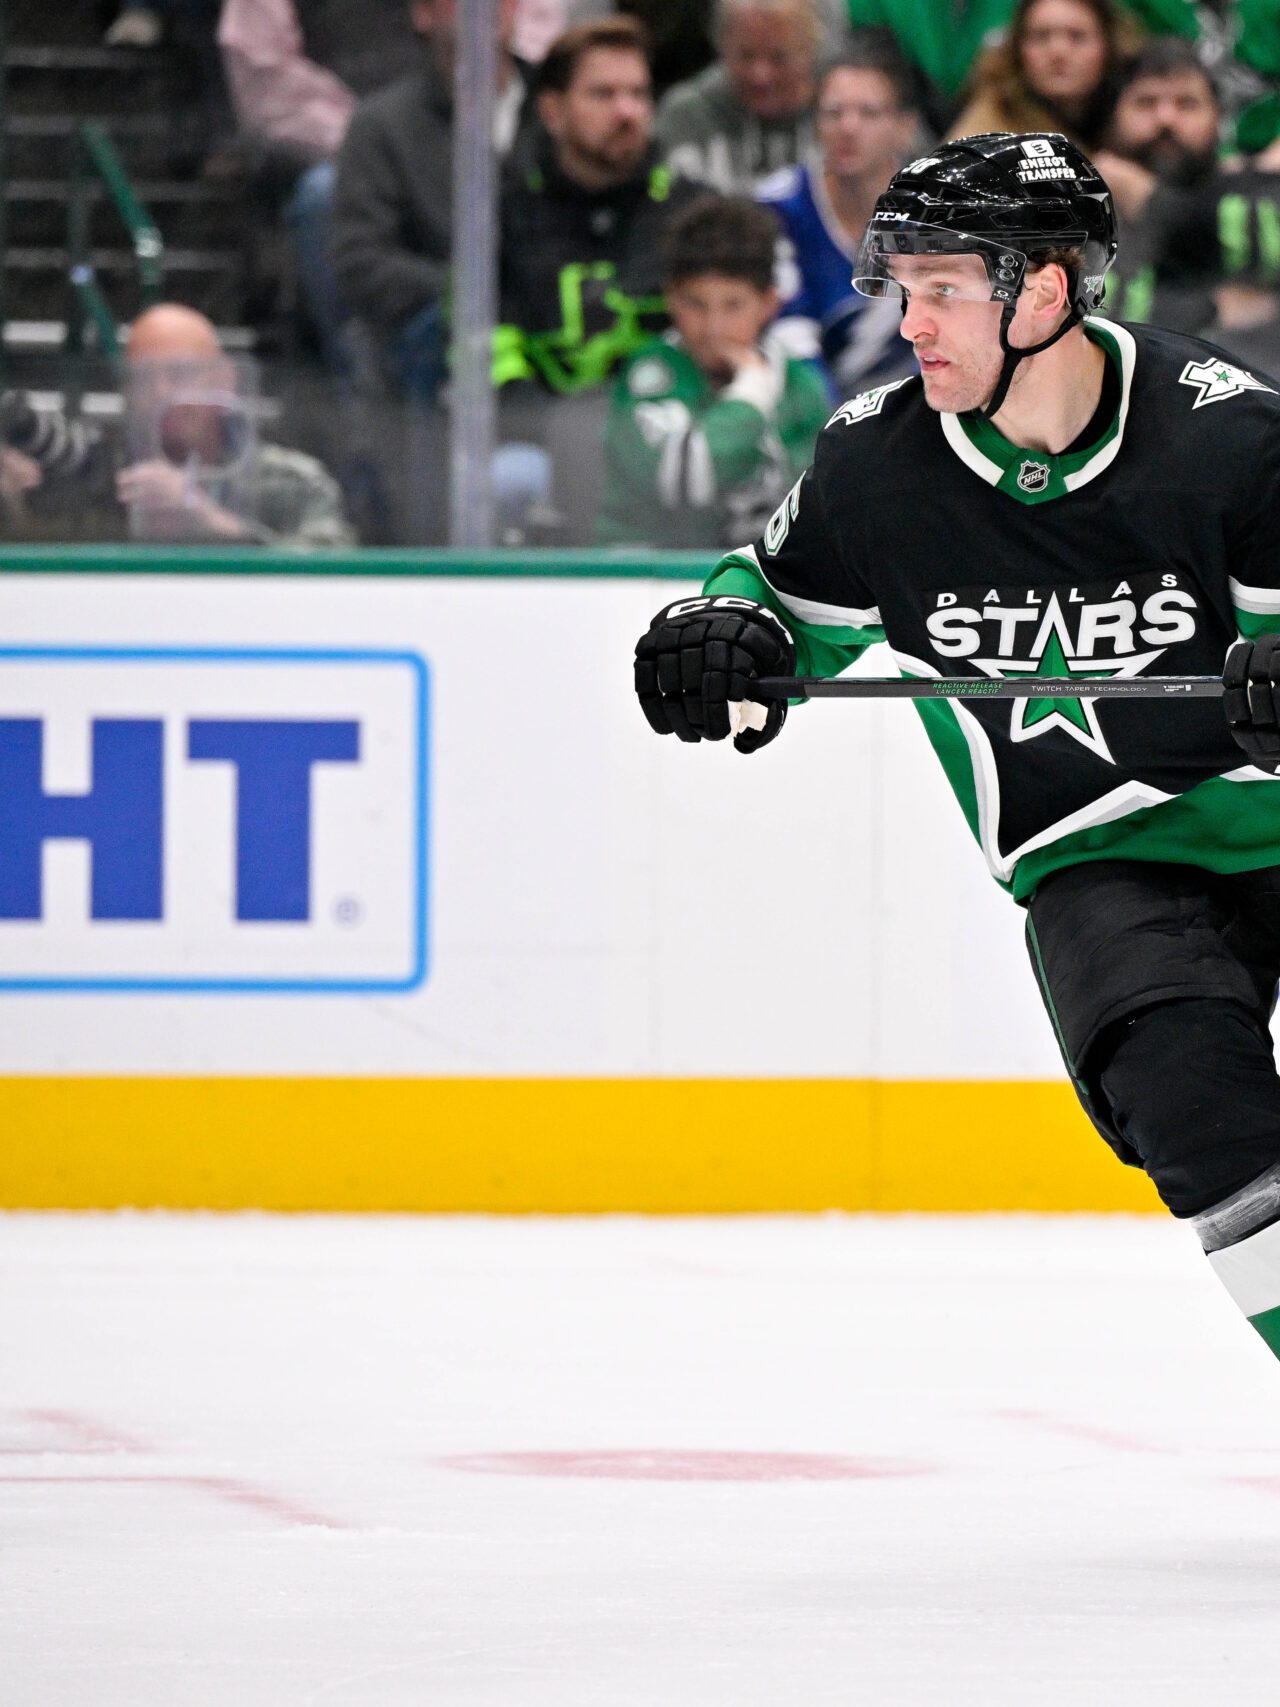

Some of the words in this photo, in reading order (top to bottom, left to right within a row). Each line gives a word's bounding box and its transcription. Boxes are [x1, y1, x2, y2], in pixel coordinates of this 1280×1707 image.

[1019, 156, 1067, 170] ENERGY
[1018, 167, 1077, 182] TRANSFER
[874, 211, 910, 221] CCM
[1023, 471, 1043, 484] NHL
[936, 573, 1177, 607] DALLAS
[926, 589, 1198, 658] STARS
[0, 717, 361, 923] HT
